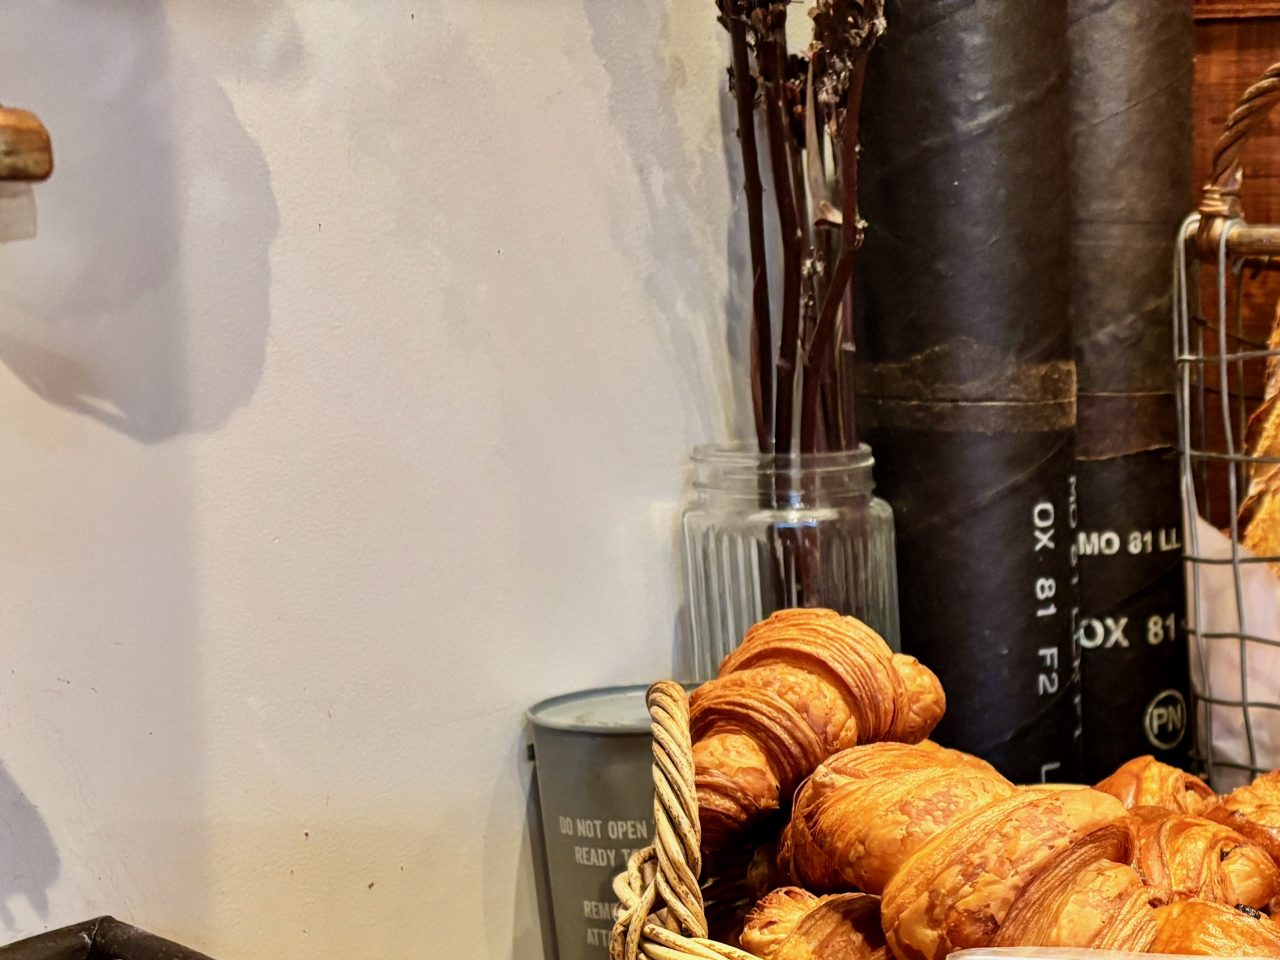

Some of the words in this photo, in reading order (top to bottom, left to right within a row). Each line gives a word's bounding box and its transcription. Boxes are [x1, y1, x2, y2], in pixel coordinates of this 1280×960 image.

[1033, 502, 1055, 551] OX
[1078, 531, 1120, 556] MO
[1127, 530, 1153, 555] 81
[1036, 577, 1057, 618] 81
[1079, 616, 1130, 649] OX
[1147, 612, 1177, 645] 81
[1037, 646, 1060, 696] F2
[1151, 705, 1182, 736] PN
[576, 817, 603, 839] NOT
[608, 820, 648, 839] OPEN
[574, 845, 616, 868] READY
